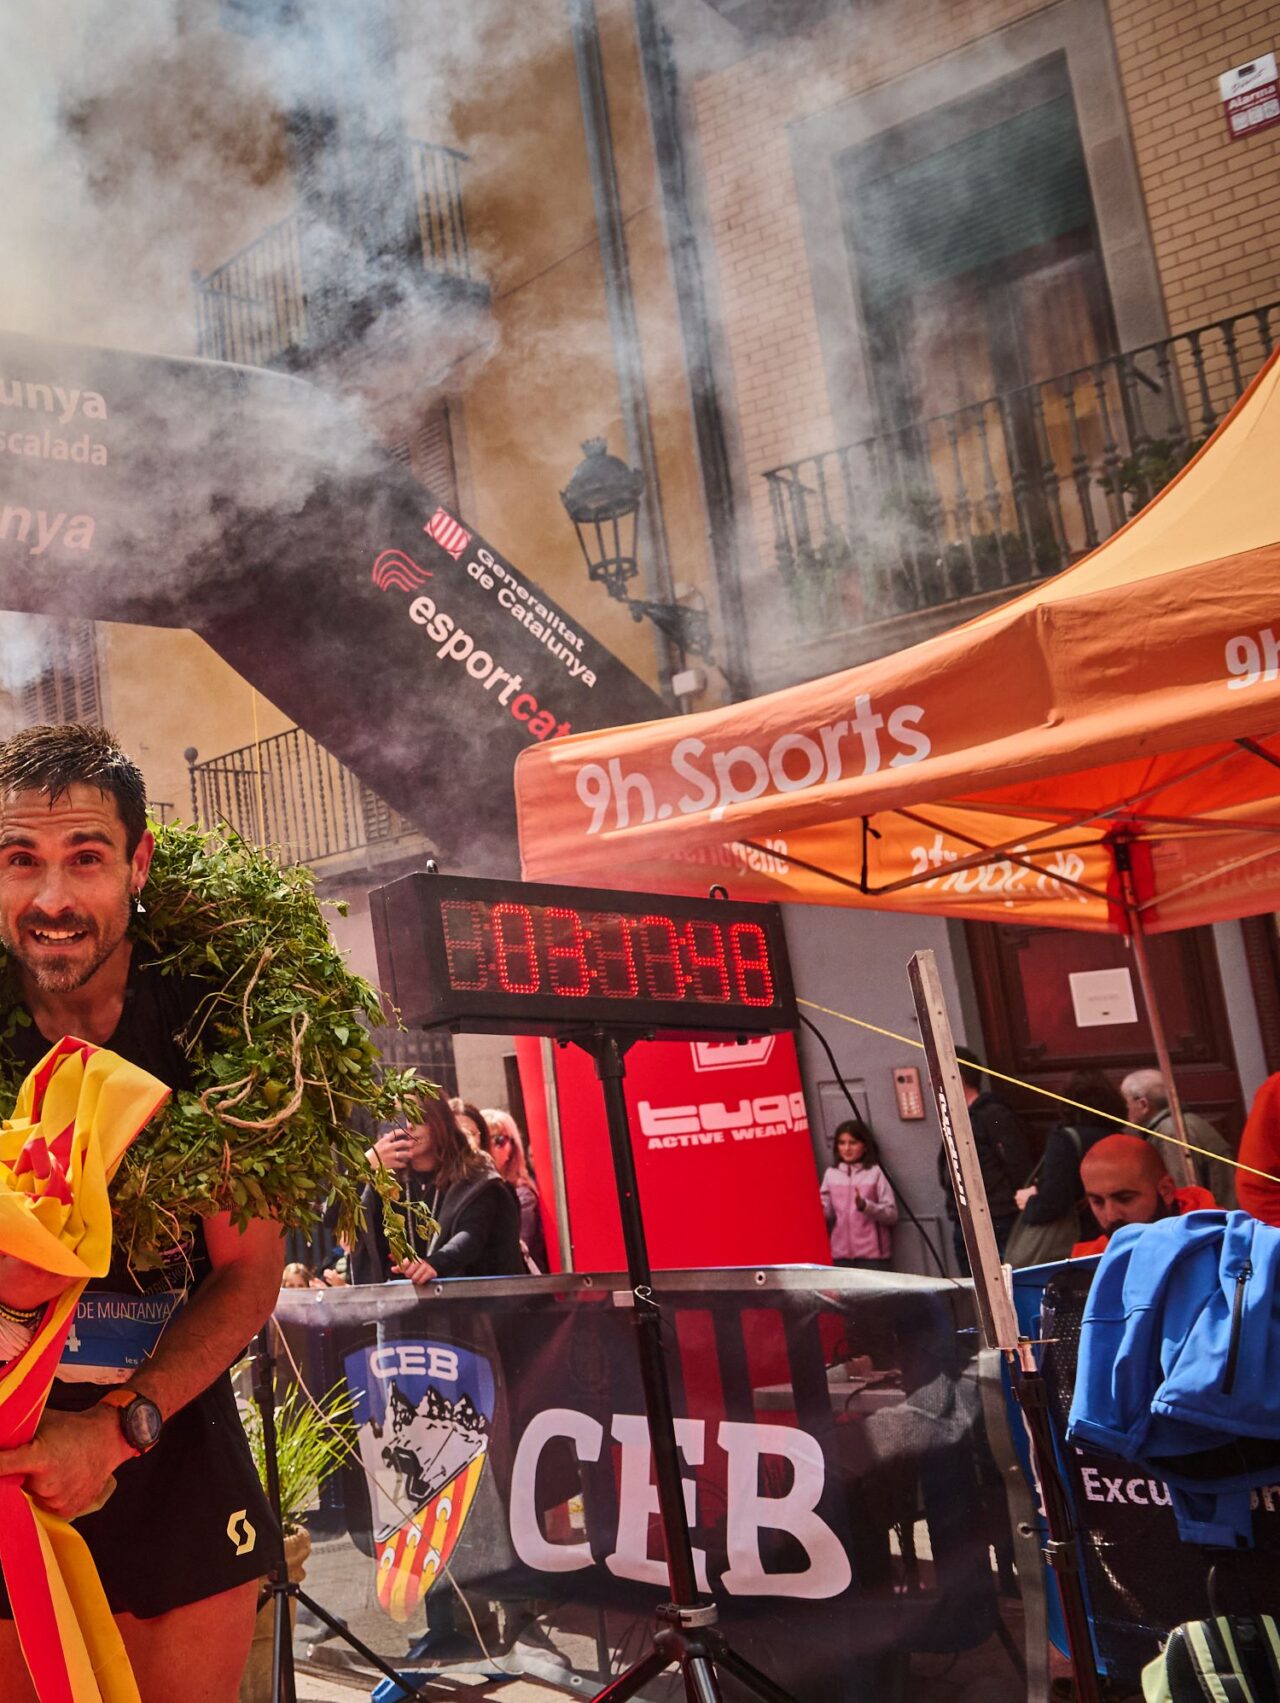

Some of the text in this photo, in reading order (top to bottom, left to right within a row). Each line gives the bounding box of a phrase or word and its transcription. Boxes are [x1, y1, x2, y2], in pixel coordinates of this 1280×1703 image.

[466, 561, 598, 689] de Catalunya
[476, 548, 586, 653] Generalitat
[575, 692, 933, 836] 9h.Sports
[647, 1123, 788, 1150] ACTIVE WEAR
[76, 1301, 173, 1320] DE MUNTANYA
[368, 1343, 460, 1384] CEB
[508, 1407, 853, 1602] CEB
